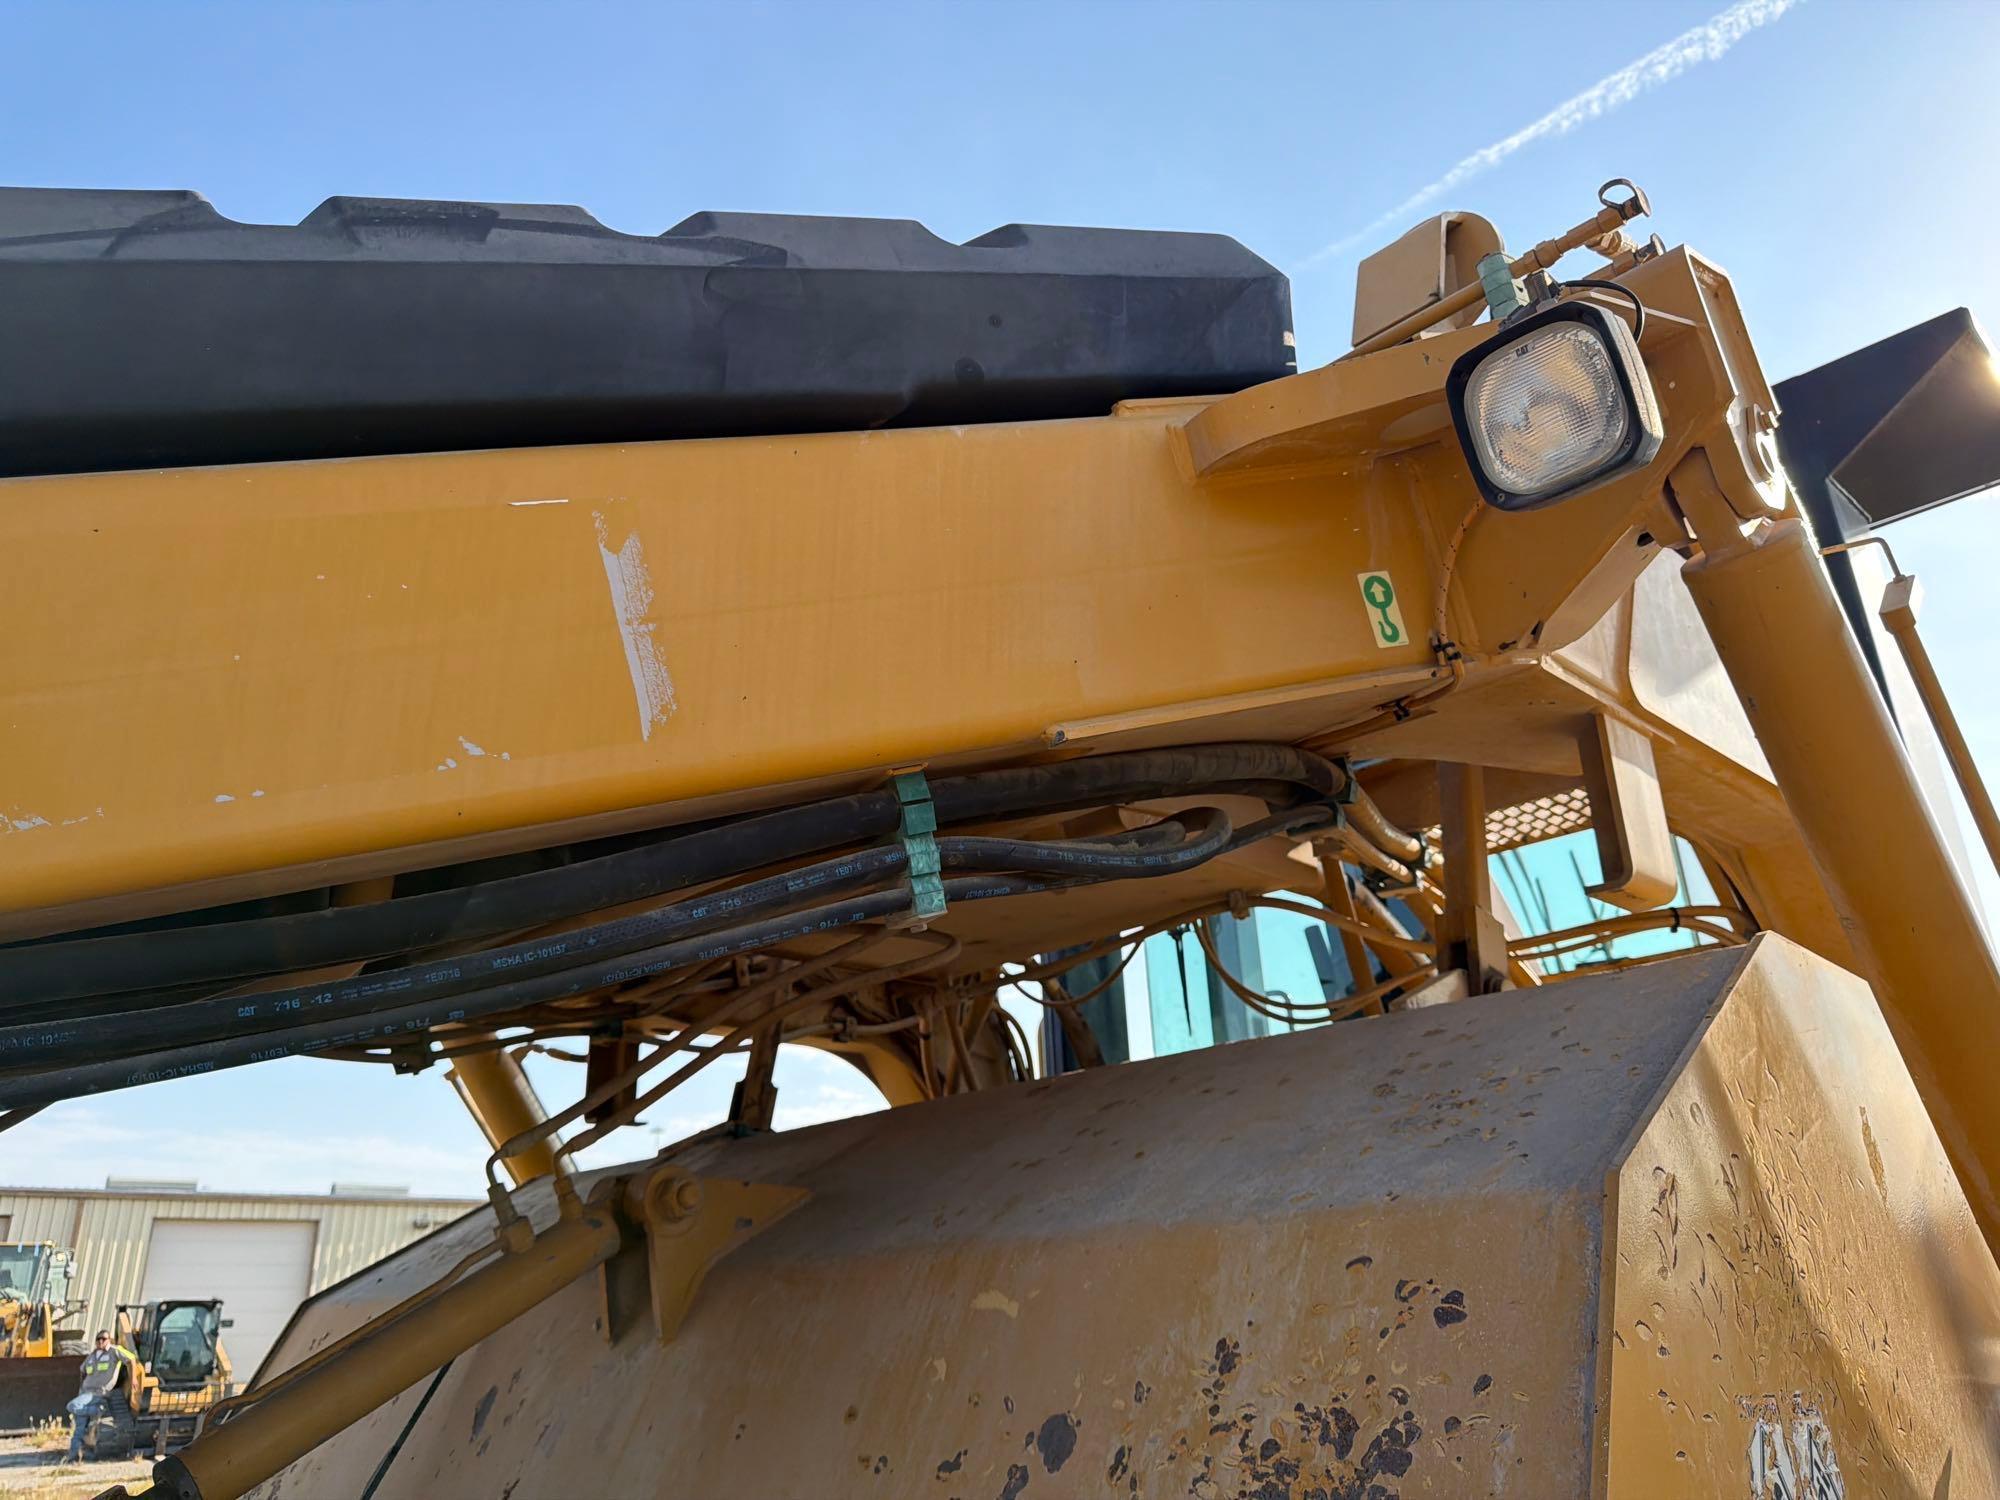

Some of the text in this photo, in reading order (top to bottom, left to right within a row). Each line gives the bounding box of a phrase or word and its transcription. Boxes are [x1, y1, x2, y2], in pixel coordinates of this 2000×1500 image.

[720, 897, 742, 911] 716
[237, 1005, 258, 1018] CAT
[273, 999, 301, 1012] 716
[492, 955, 523, 969] MSHA
[406, 1016, 432, 1029] 716
[250, 1046, 290, 1061] 1E0716
[180, 1060, 215, 1075] MSHA
